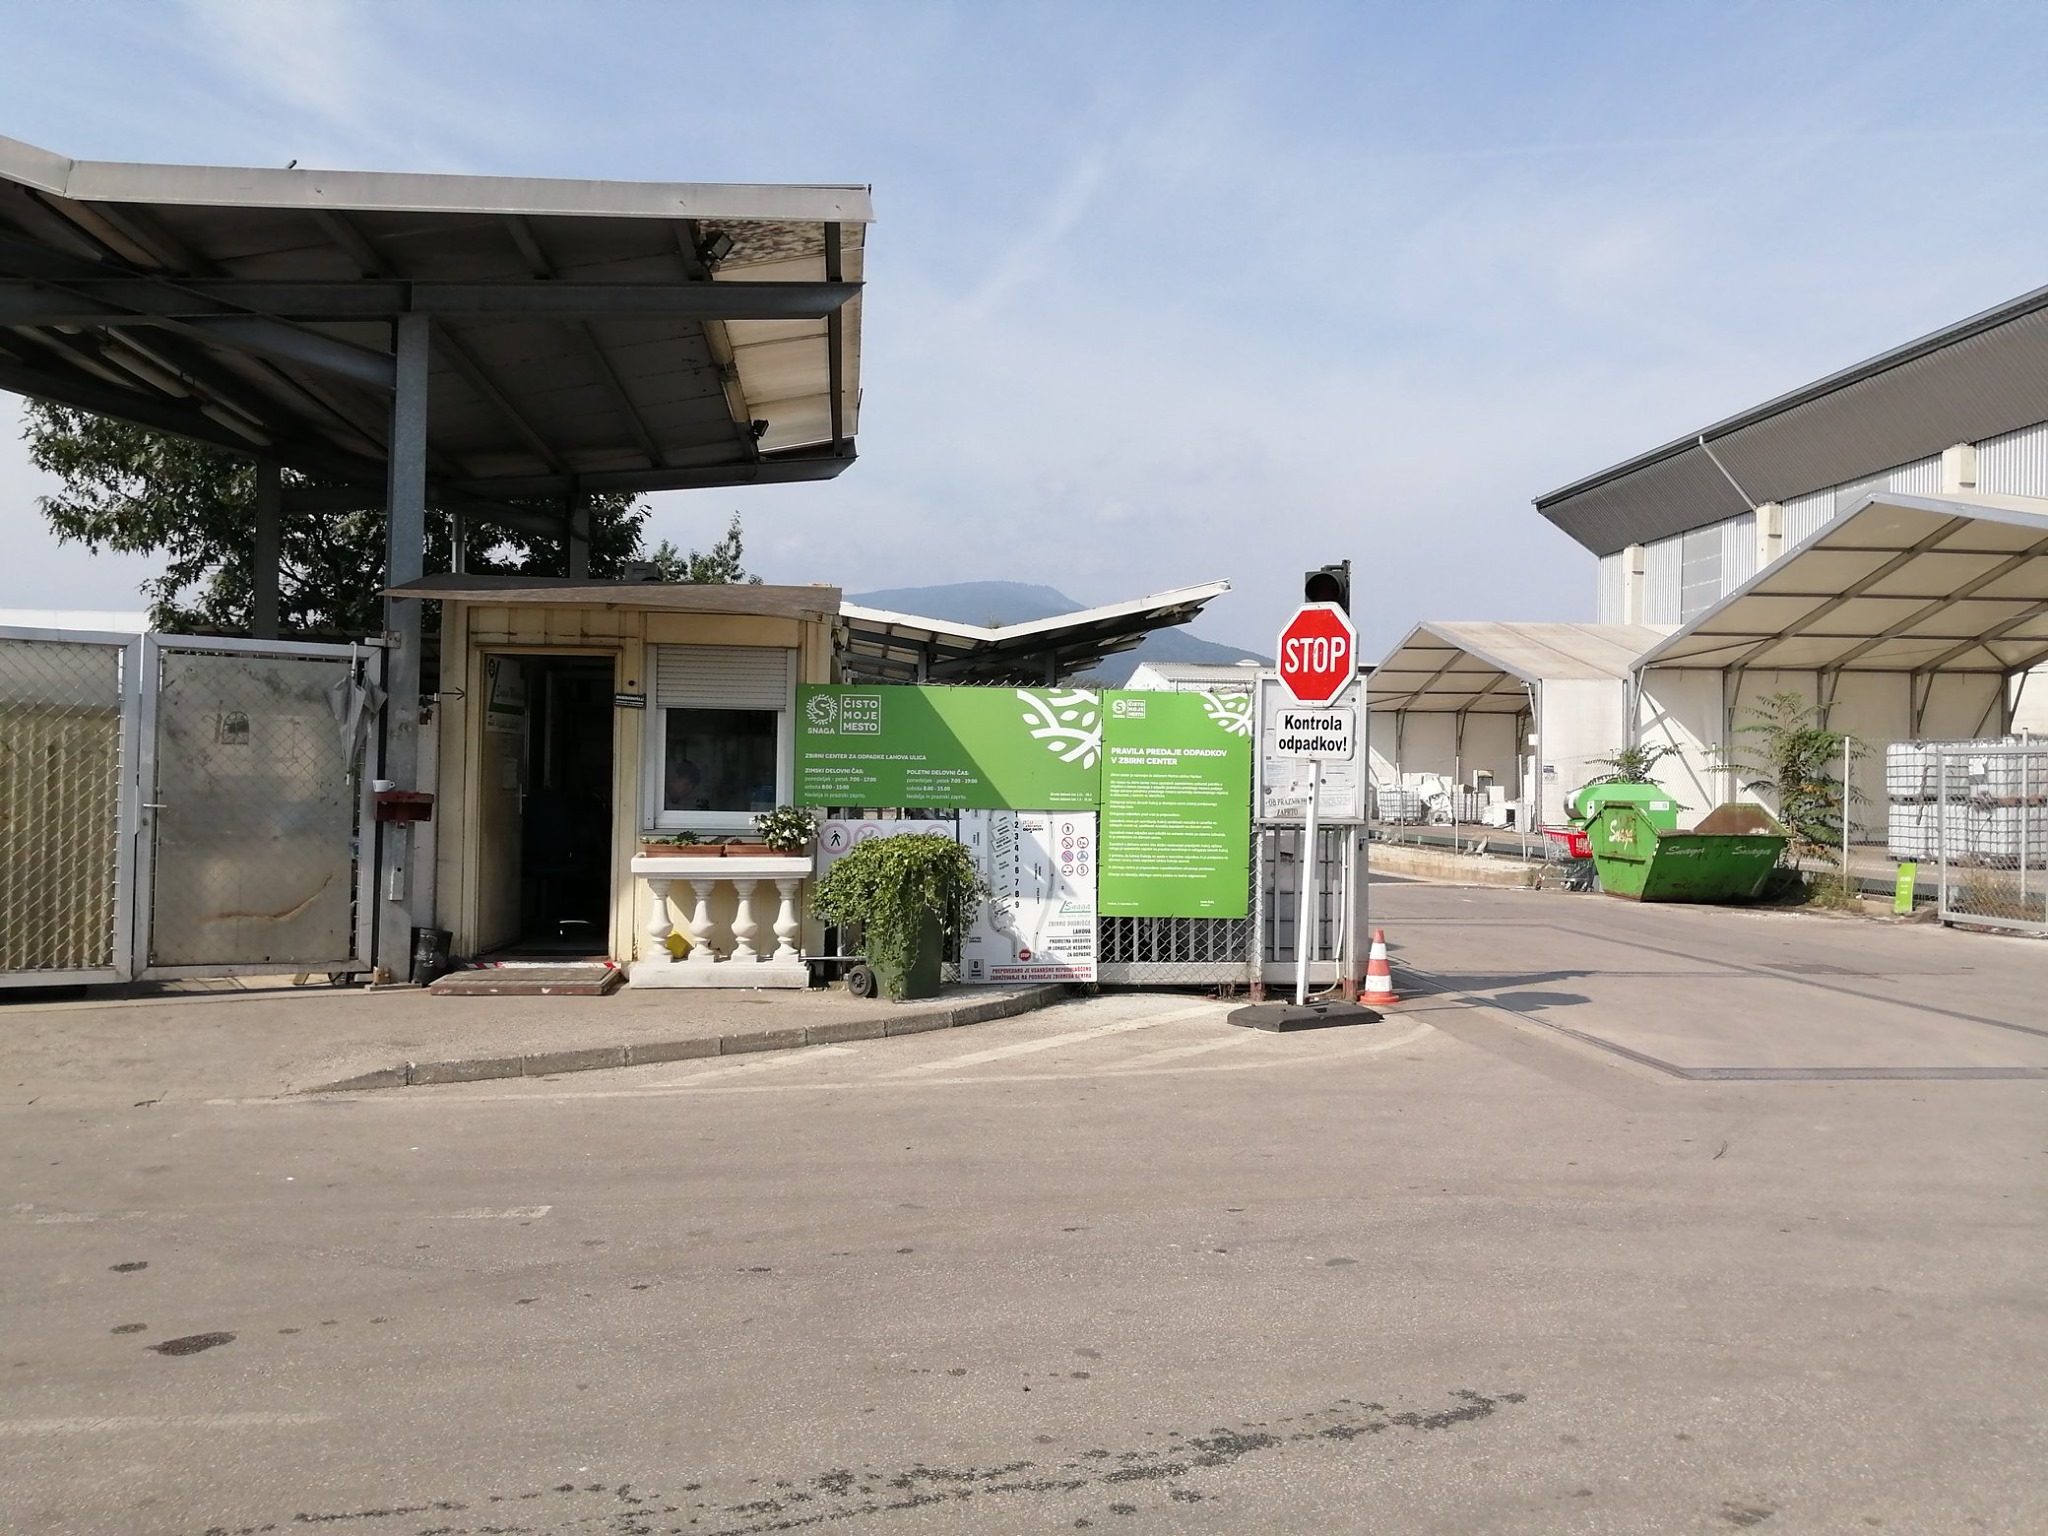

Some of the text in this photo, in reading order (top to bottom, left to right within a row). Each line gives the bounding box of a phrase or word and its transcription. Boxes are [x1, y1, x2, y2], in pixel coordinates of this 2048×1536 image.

[1284, 636, 1346, 674] STOP
[844, 698, 878, 709] ČISTO
[844, 711, 878, 720] MOJE
[843, 722, 878, 732] MESTO
[1284, 714, 1342, 731] Kontrola
[1278, 736, 1347, 754] odpadkov!
[1277, 808, 1299, 816] ZAPRTO
[1064, 902, 1090, 911] Snaga
